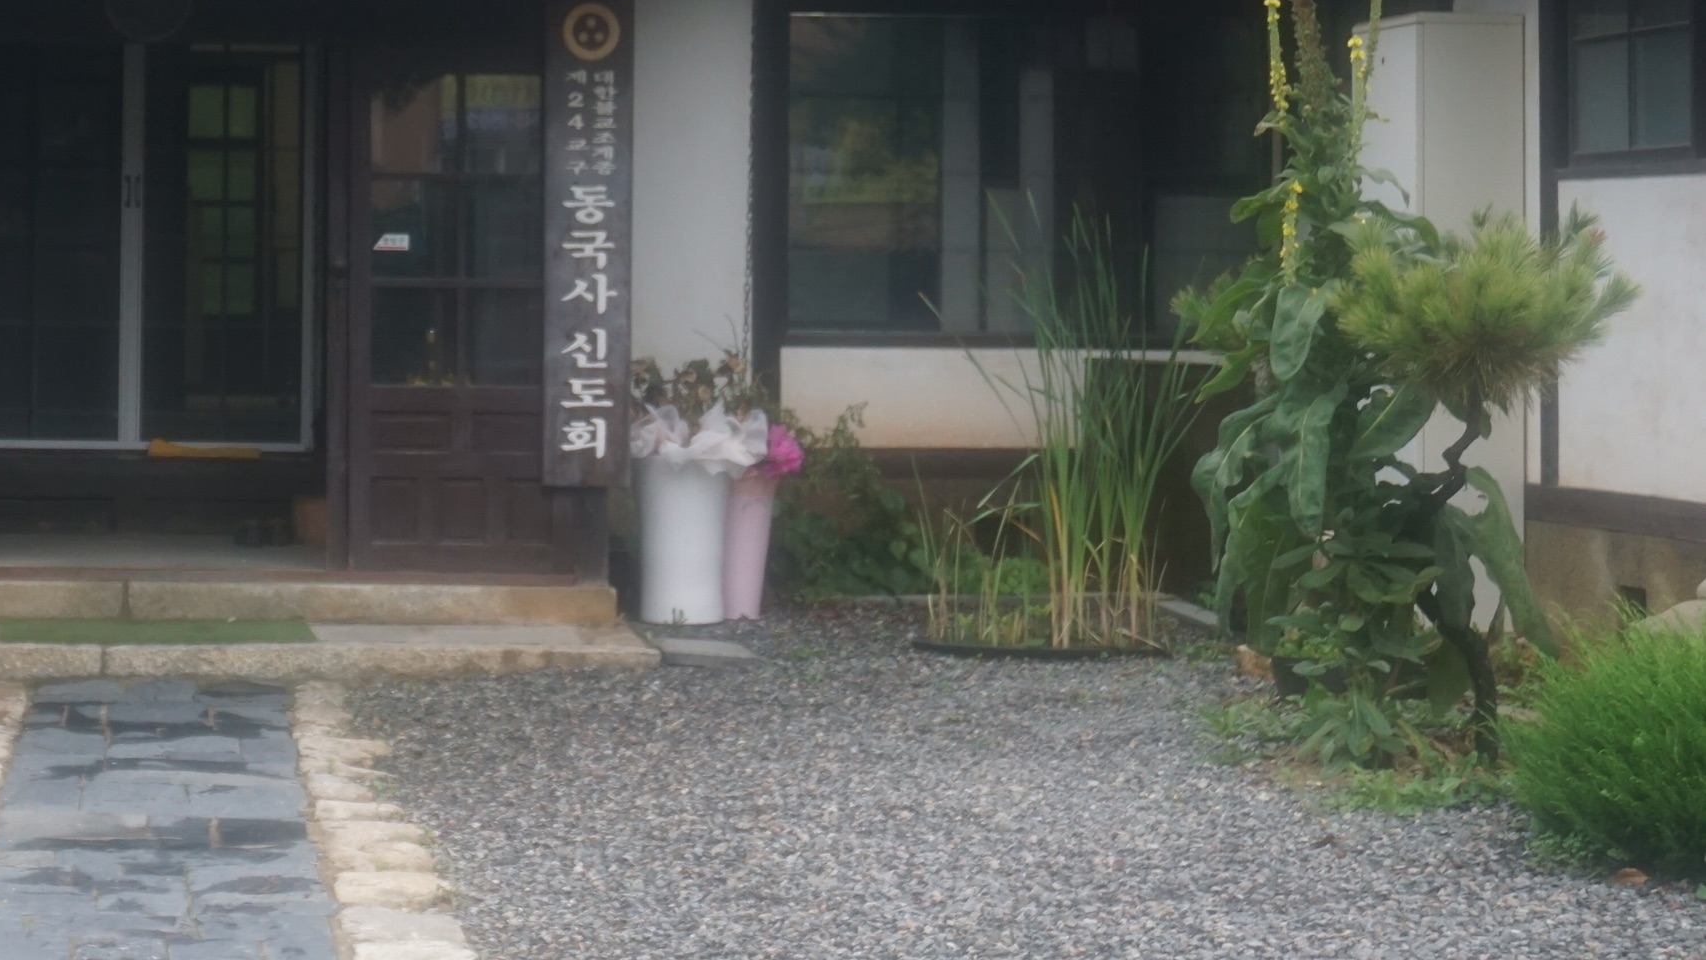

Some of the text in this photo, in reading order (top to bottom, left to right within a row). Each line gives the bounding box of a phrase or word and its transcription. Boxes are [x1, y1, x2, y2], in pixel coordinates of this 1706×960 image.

[565, 70, 589, 176] 제24교구
[592, 70, 619, 176] 대한불교조계종
[560, 185, 618, 460] 동국사 신도회
